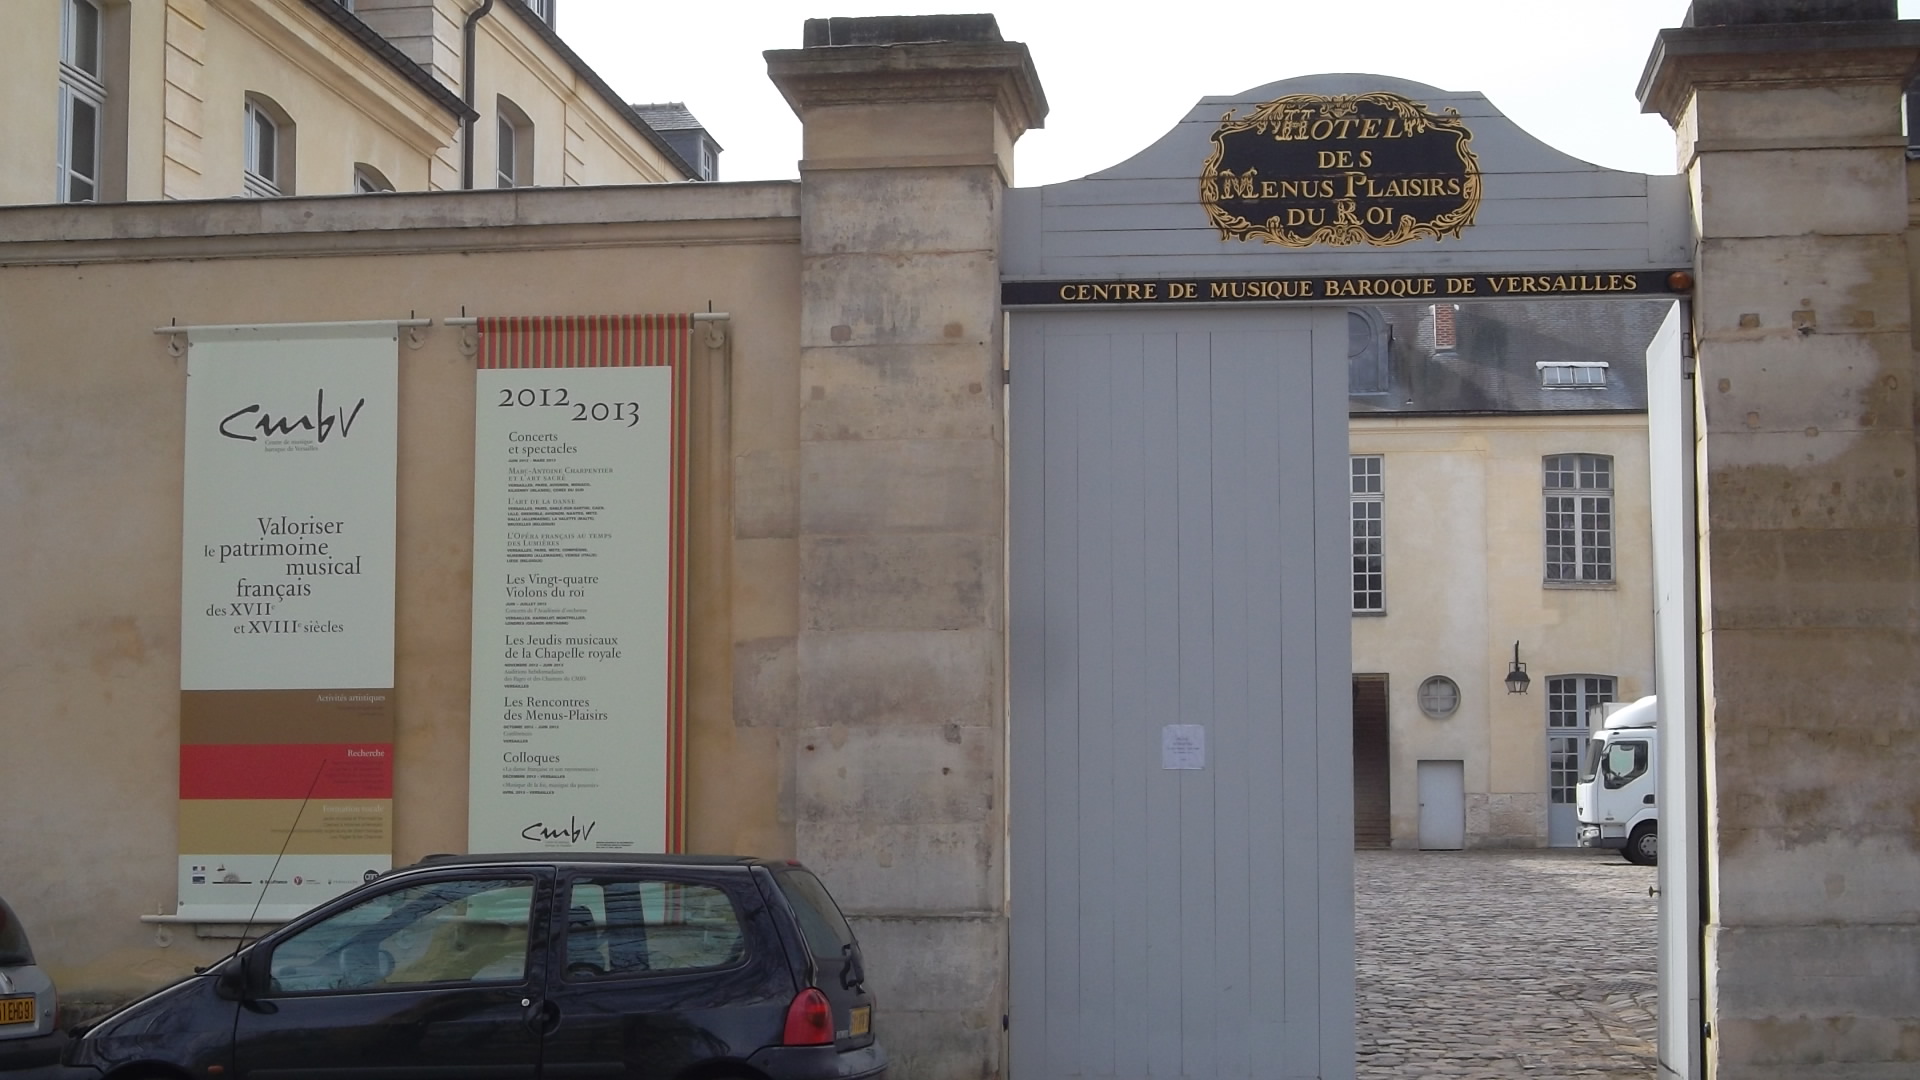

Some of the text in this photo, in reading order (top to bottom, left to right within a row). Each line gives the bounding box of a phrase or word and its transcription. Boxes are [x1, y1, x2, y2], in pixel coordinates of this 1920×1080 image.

[1318, 150, 1372, 169] DES
[1219, 167, 1461, 199] MENUS PLAISIRS
[1287, 198, 1394, 226] DU ROI
[1060, 274, 1638, 301] CENTRE DE MUSIQUE BAROQUE DE VERSAILLES
[498, 388, 570, 407] 2012
[571, 402, 640, 428] 2013
[508, 431, 558, 442] Concerts
[508, 443, 577, 457] et spectacles
[257, 515, 345, 535] Valoriser
[204, 536, 329, 564] le patrimoine
[286, 555, 361, 575] musical
[506, 573, 599, 587] Les Vingt-quatre
[236, 577, 312, 602] français
[505, 586, 585, 598] Violons du roi
[206, 604, 227, 616] des
[233, 624, 245, 634] et
[303, 620, 344, 633] siècles
[505, 634, 618, 645] Les Jeudis musicaux
[504, 647, 622, 662] de la Chapelle royale
[504, 696, 590, 707] Les Rencontres
[503, 709, 608, 720] des Menus-Plaisirs
[347, 749, 385, 757] Recherche
[503, 751, 560, 766] Colloques
